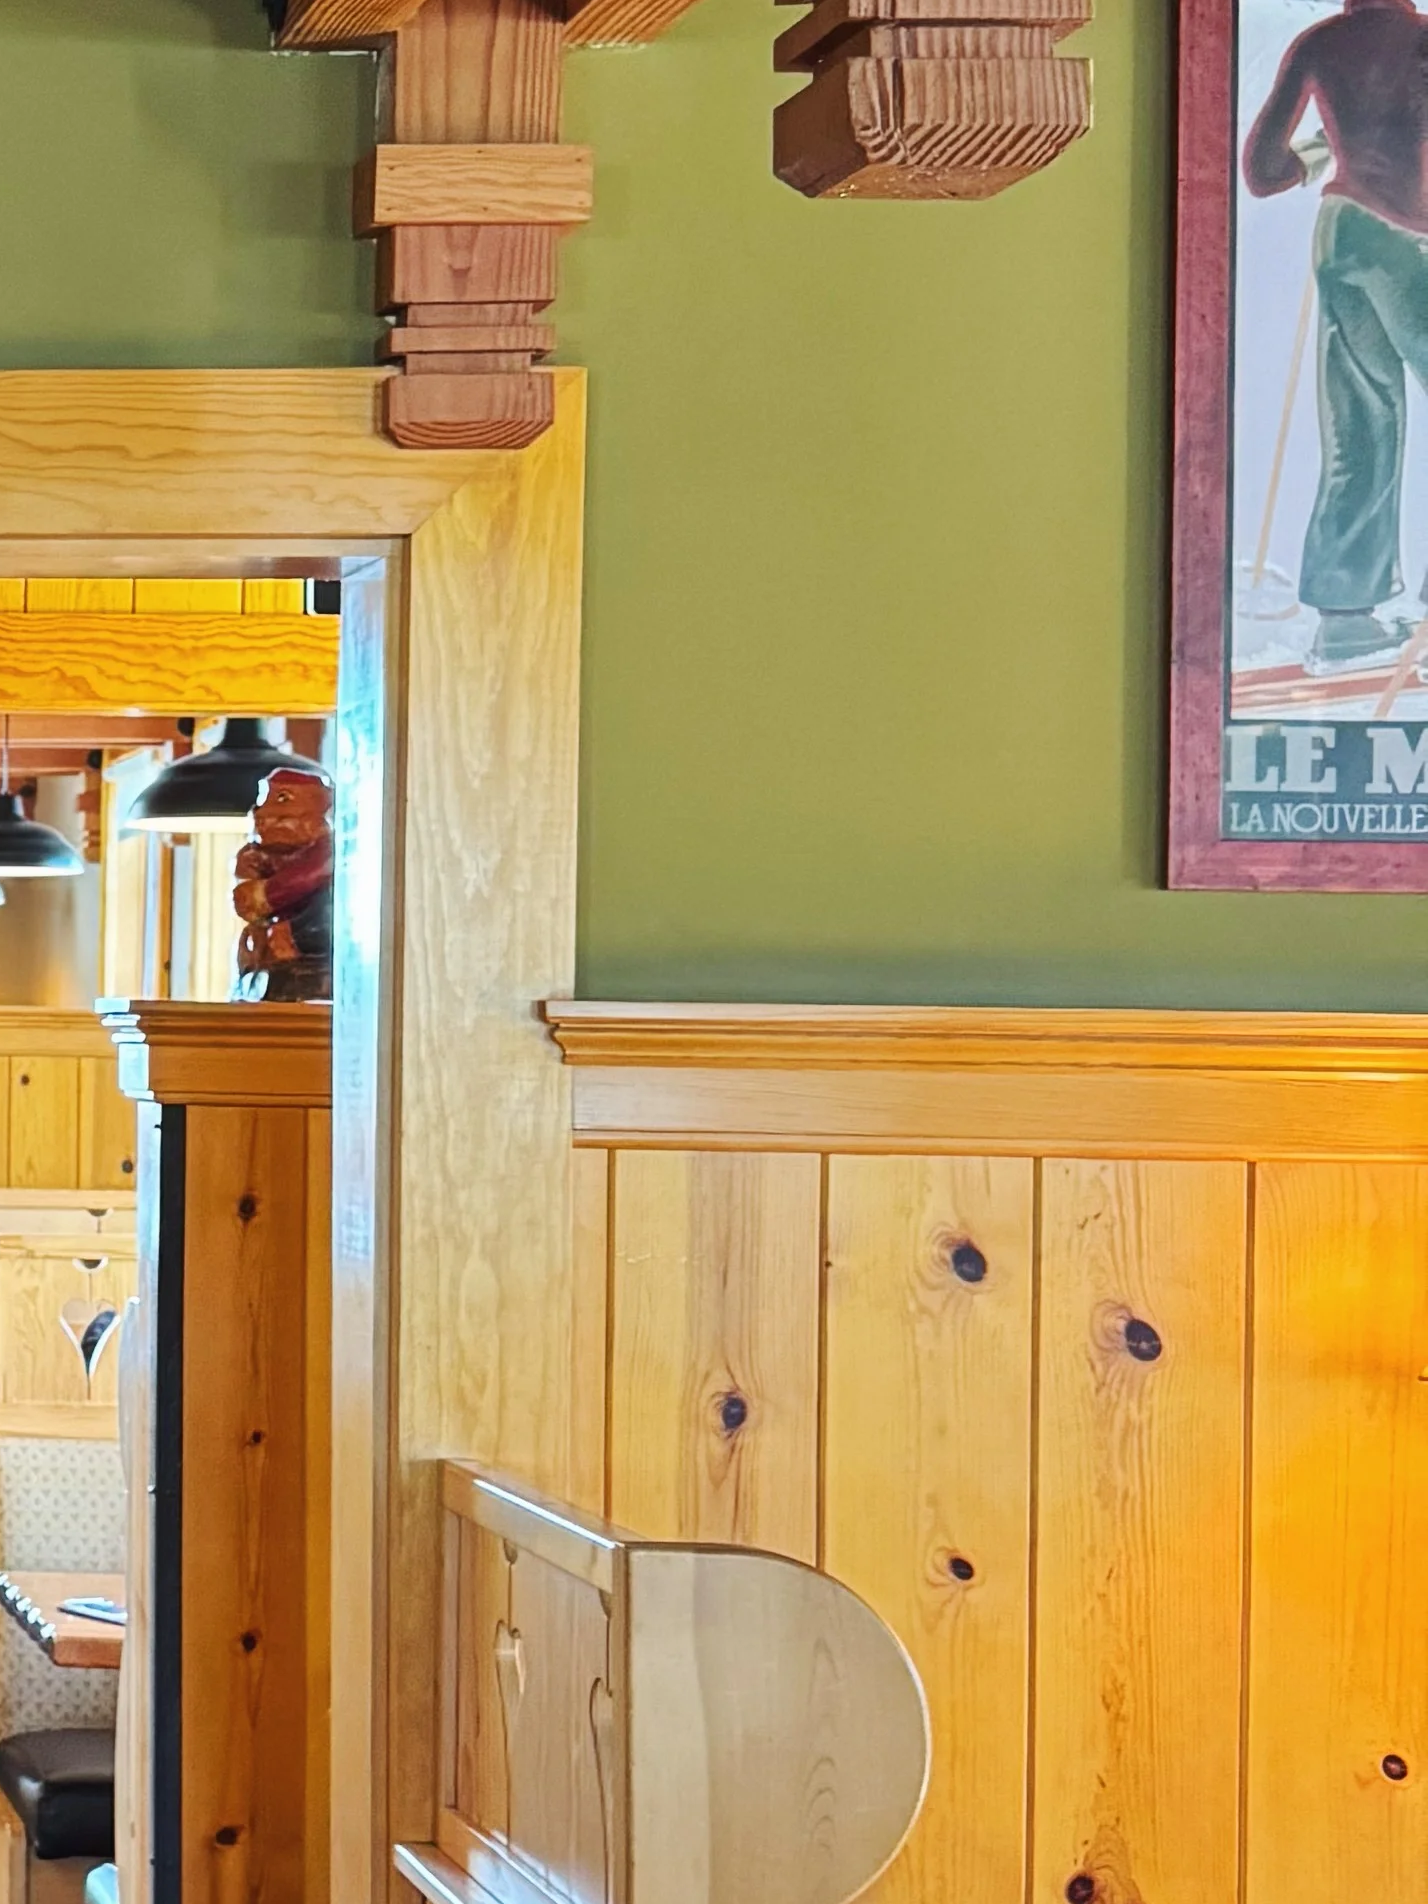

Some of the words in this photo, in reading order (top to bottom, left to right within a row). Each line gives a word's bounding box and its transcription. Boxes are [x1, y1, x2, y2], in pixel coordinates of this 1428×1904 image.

[1225, 724, 1337, 793] LE
[1364, 727, 1428, 794] M
[1229, 802, 1267, 833] LA
[1271, 802, 1428, 834] NOUVELLE
